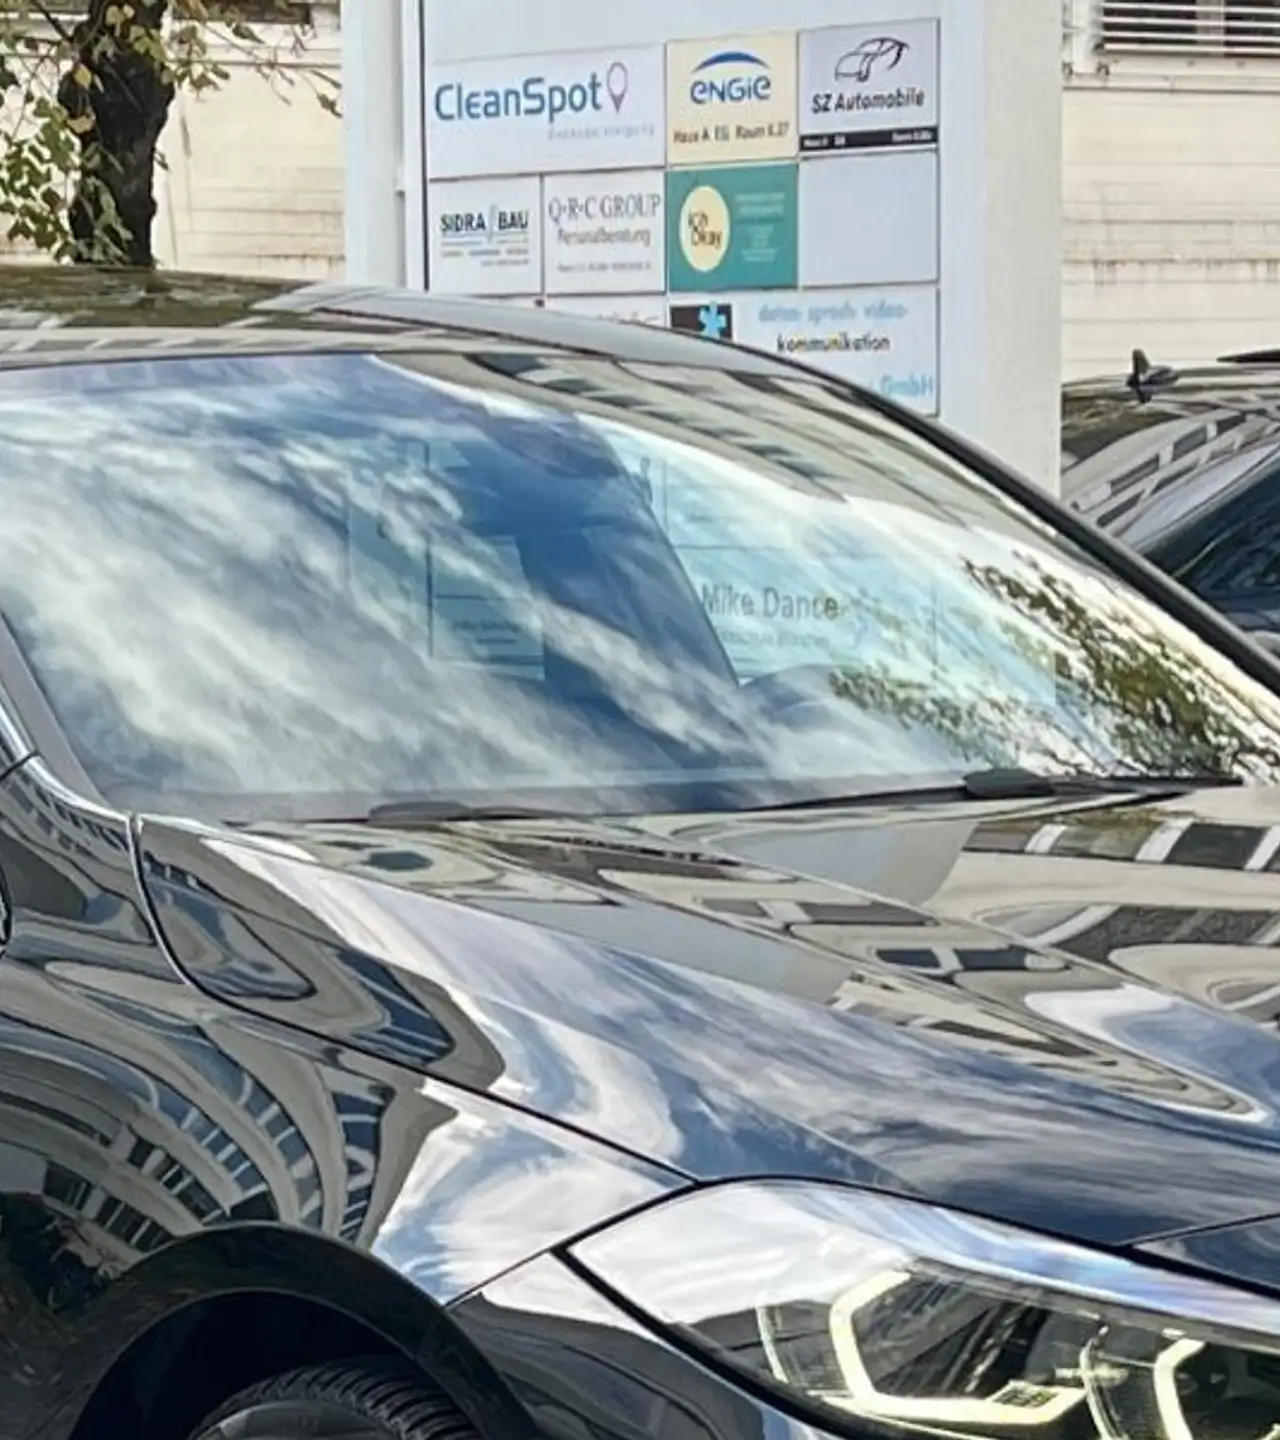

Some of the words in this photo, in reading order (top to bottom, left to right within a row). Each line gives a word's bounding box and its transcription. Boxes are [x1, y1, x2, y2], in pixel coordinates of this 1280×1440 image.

[434, 71, 602, 123] CleanSpot
[811, 92, 831, 114] SZ
[599, 192, 663, 218] GROUP
[440, 211, 486, 232] SIDRA
[498, 209, 529, 230] BAU
[762, 587, 838, 621] Dance
